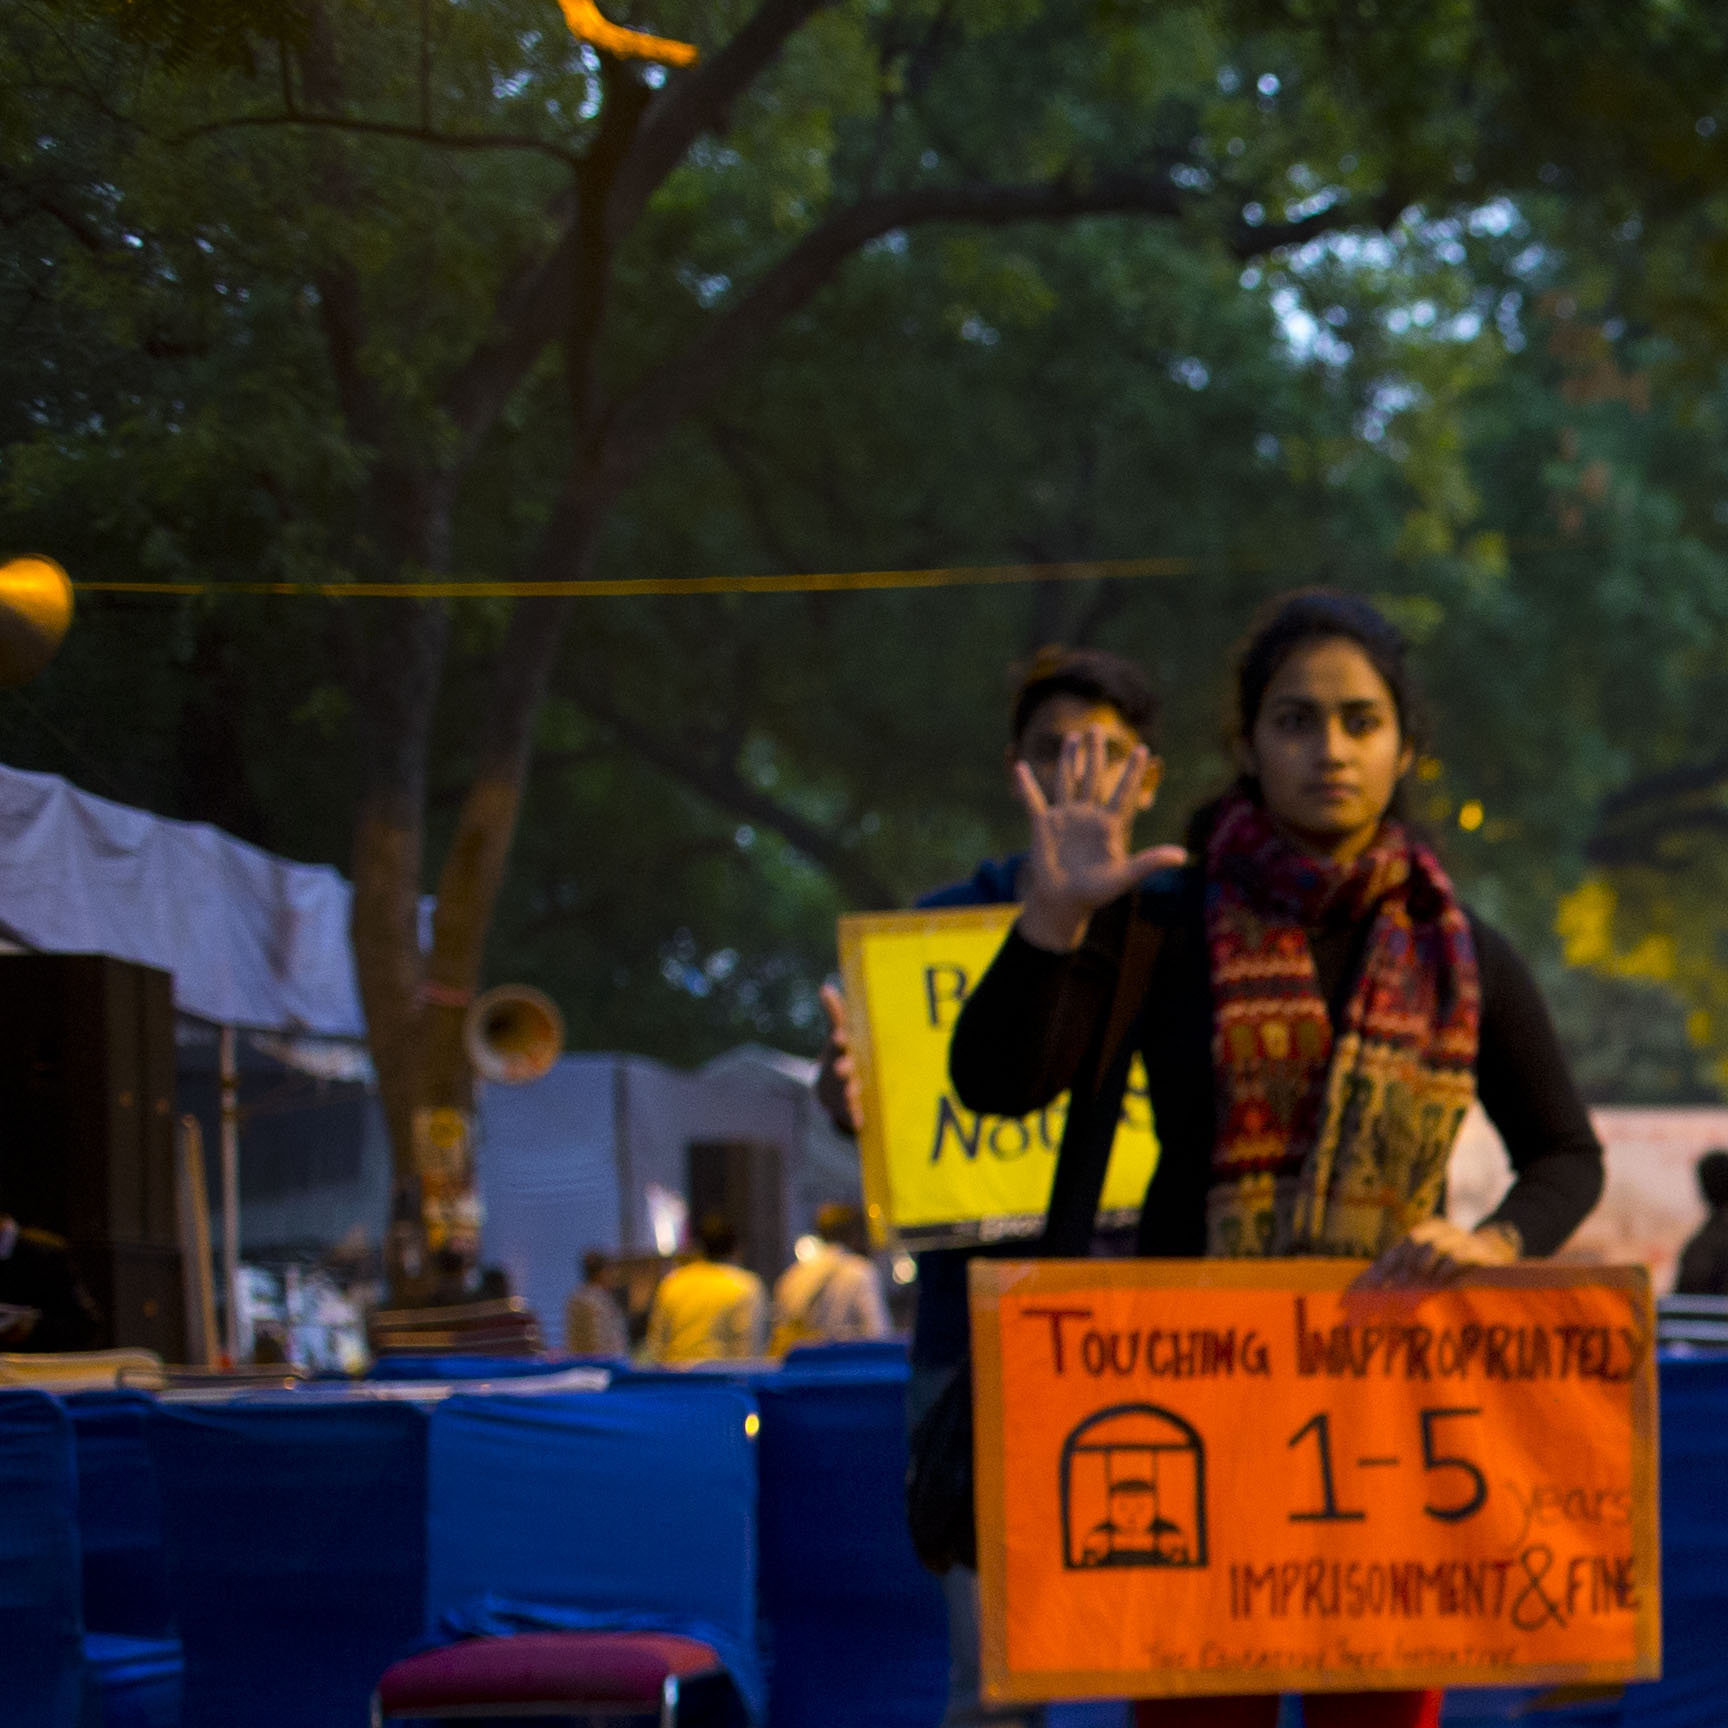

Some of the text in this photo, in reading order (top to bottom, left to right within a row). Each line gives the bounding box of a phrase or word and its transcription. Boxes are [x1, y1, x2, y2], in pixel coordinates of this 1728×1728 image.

[1021, 1308, 1271, 1378] TOUCHING
[1287, 1406, 1488, 1523] 1-5
[1229, 1543, 1643, 1633] IMPRISONMENT & FINE
